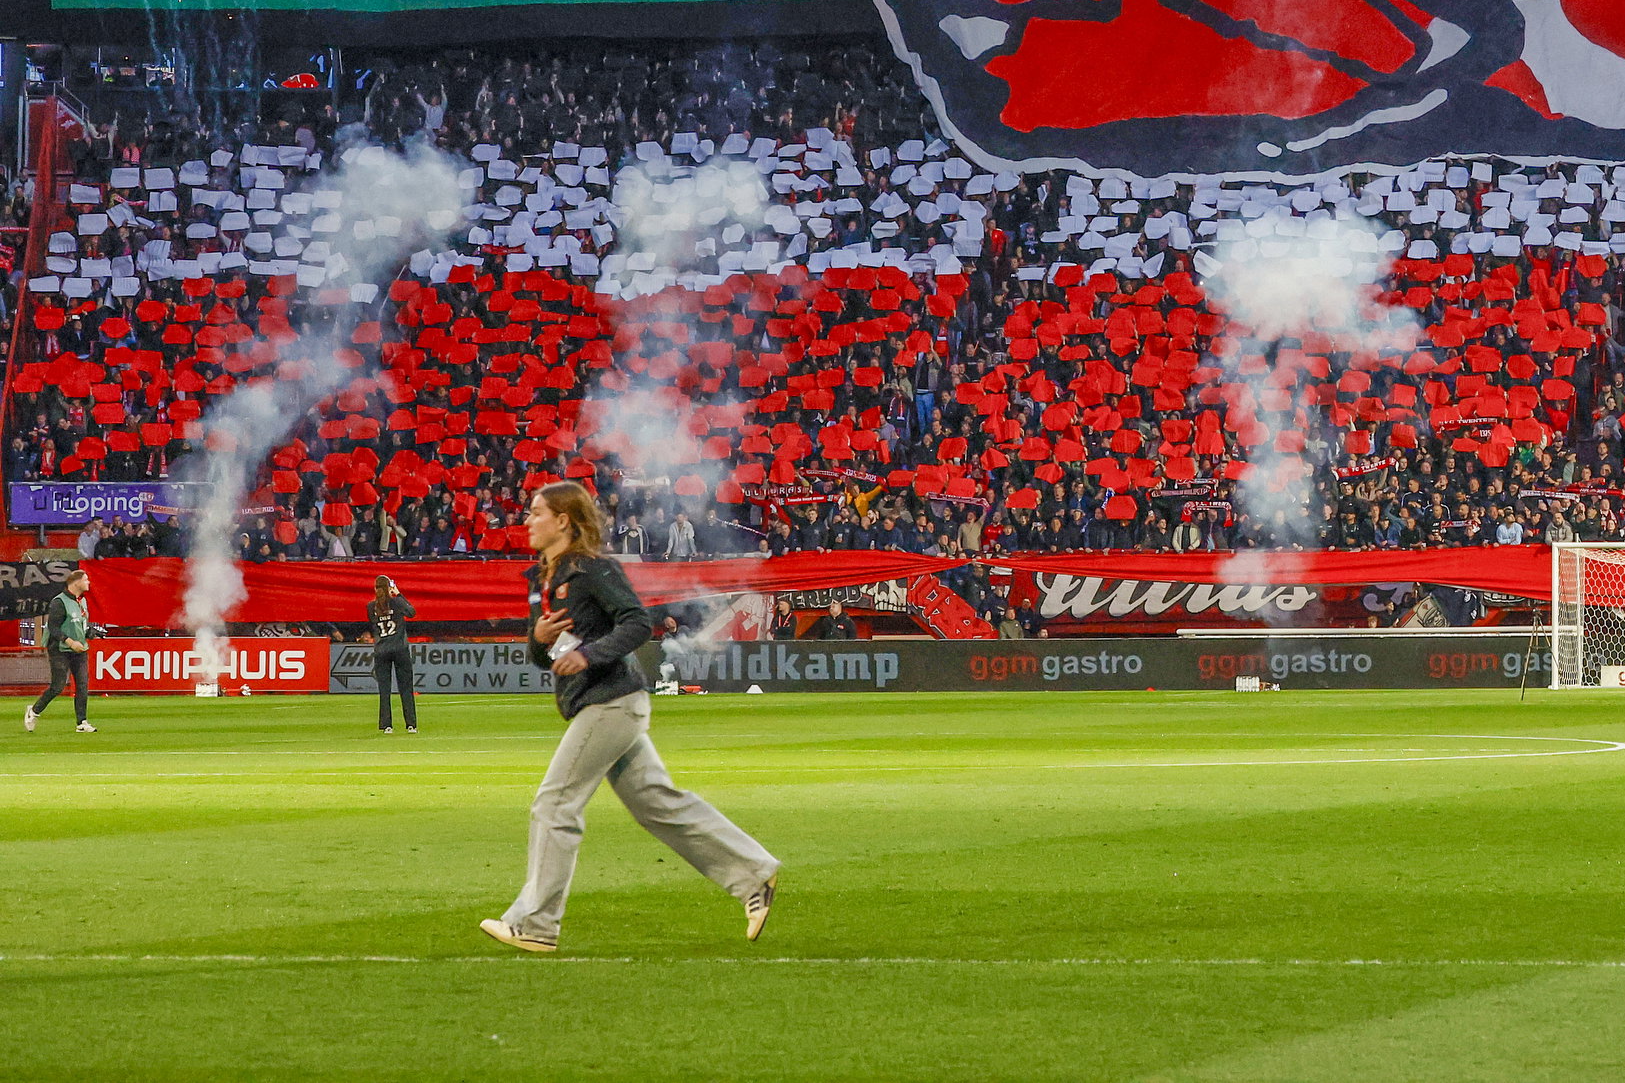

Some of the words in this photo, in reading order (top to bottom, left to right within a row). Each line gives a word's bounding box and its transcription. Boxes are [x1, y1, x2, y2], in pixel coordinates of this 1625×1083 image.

[377, 620, 396, 637] 12
[95, 650, 306, 680] KAMPHUIS
[411, 645, 486, 667] Henny
[676, 644, 900, 688] wildkamp
